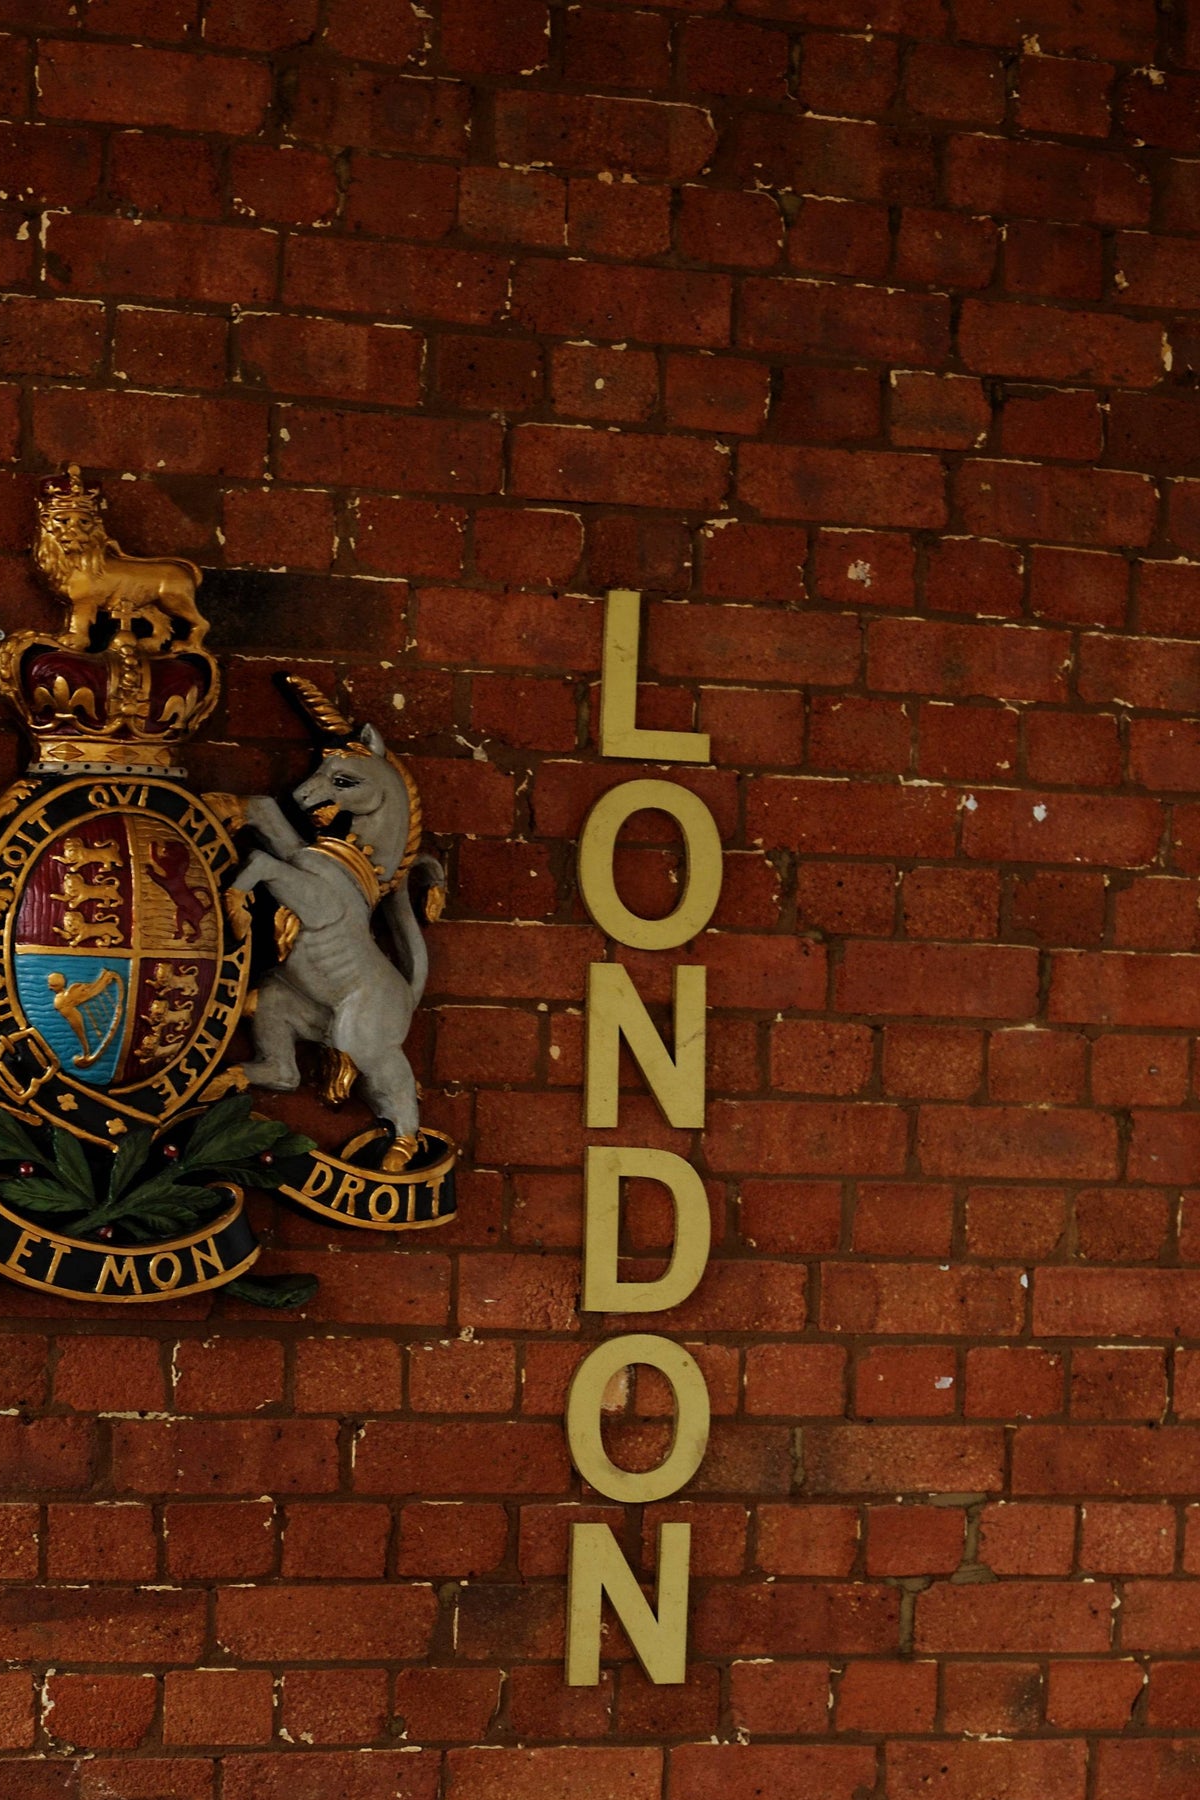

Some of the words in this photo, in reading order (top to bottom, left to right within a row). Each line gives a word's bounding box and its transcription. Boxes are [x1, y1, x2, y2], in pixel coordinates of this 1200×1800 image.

[178, 805, 234, 887] MAL
[152, 978, 239, 1110] PENSE
[566, 590, 724, 1687] LONDON
[5, 1230, 72, 1285] ET
[95, 1236, 225, 1295] MON
[300, 1160, 446, 1223] DROIT
